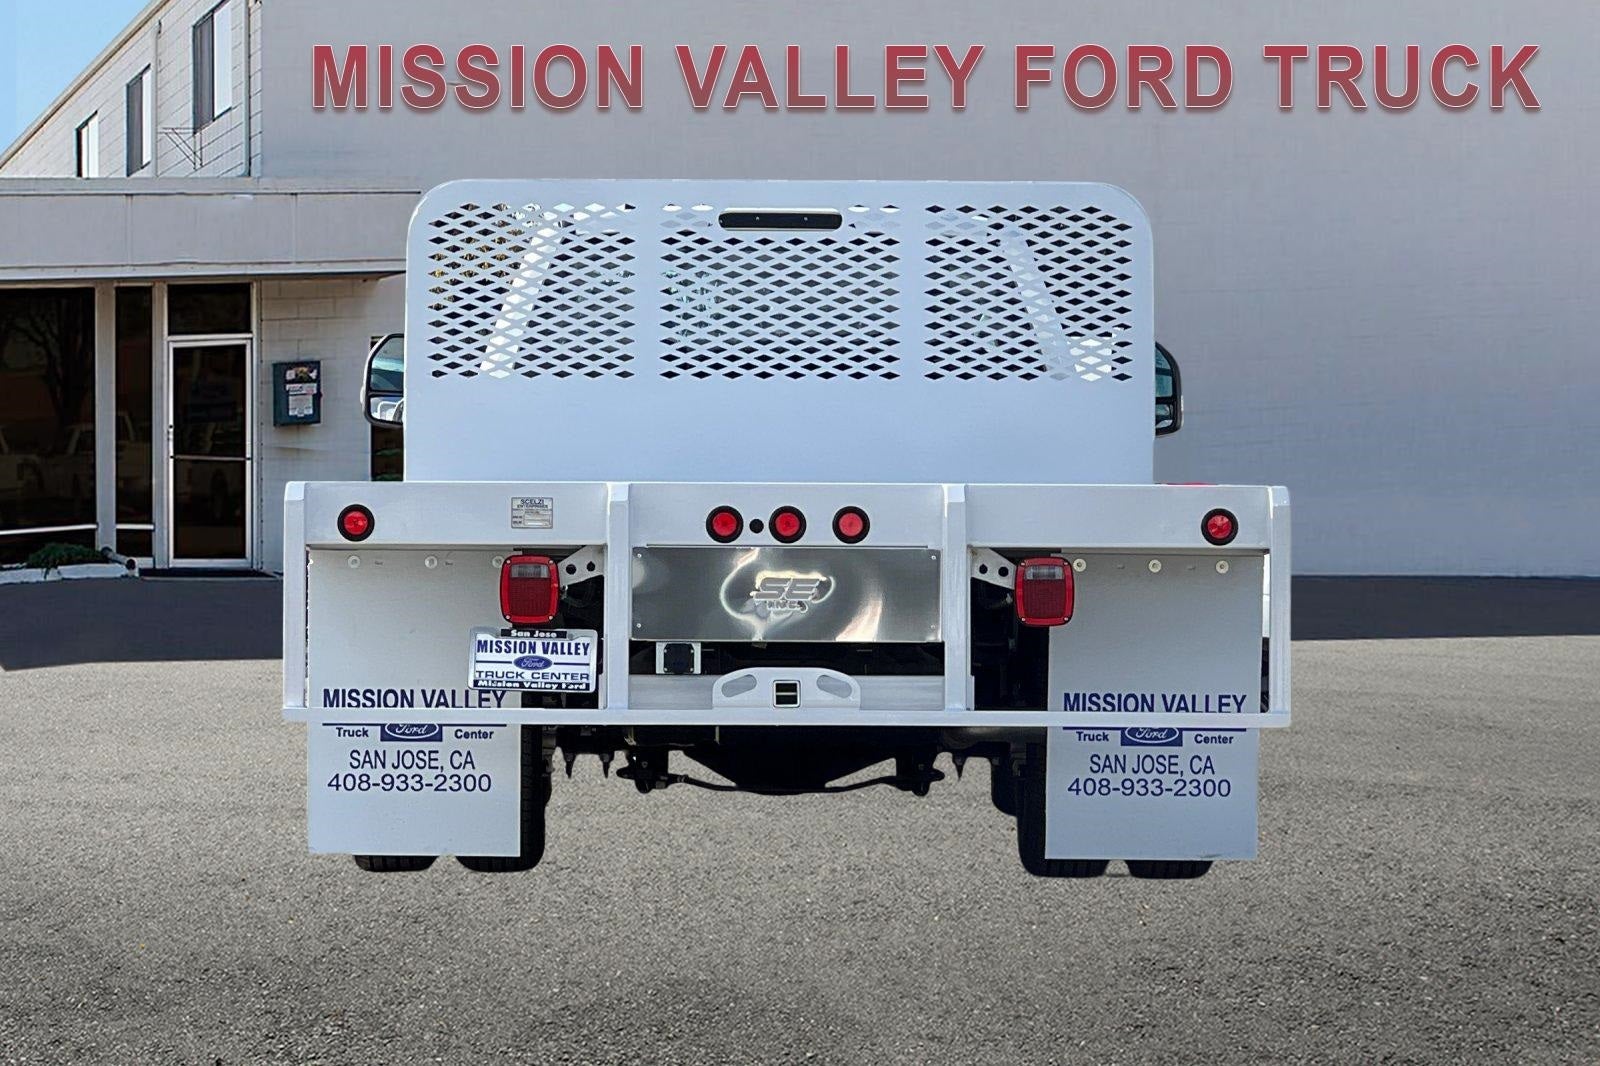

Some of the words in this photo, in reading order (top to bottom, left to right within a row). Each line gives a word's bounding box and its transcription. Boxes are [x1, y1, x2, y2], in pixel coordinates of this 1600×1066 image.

[311, 43, 644, 109] MISSION
[675, 43, 986, 109] VALLEY
[1014, 43, 1234, 109] FORD
[1262, 43, 1542, 109] TRUCK
[511, 629, 531, 638] San
[533, 630, 557, 638] Jose
[476, 639, 537, 654] MISSION
[541, 641, 590, 656] VALLEY
[520, 657, 545, 668] Ford
[476, 670, 525, 680] TRUCK
[531, 672, 590, 681] CENTER
[477, 679, 520, 688] Mission
[523, 681, 558, 690] Valley
[561, 682, 586, 690] Ford
[323, 688, 415, 708] MISSION
[421, 689, 507, 709] VALLEY
[1063, 692, 1155, 712] MISSION
[1161, 693, 1247, 713] VALLEY
[335, 726, 369, 738] Truck
[395, 723, 428, 734] Ford
[454, 728, 494, 740] Center
[1075, 731, 1109, 742] Truck
[1135, 727, 1168, 738] Ford
[1194, 733, 1234, 744] Center
[349, 749, 386, 770] SAN
[391, 749, 444, 773] JOSE,
[450, 750, 476, 770] CA
[1089, 753, 1126, 774] SAN
[1131, 754, 1184, 777] JOSE,
[1189, 754, 1215, 775] CA
[327, 773, 492, 792] 408-933-2300
[1067, 777, 1231, 797] 408-933-2300
